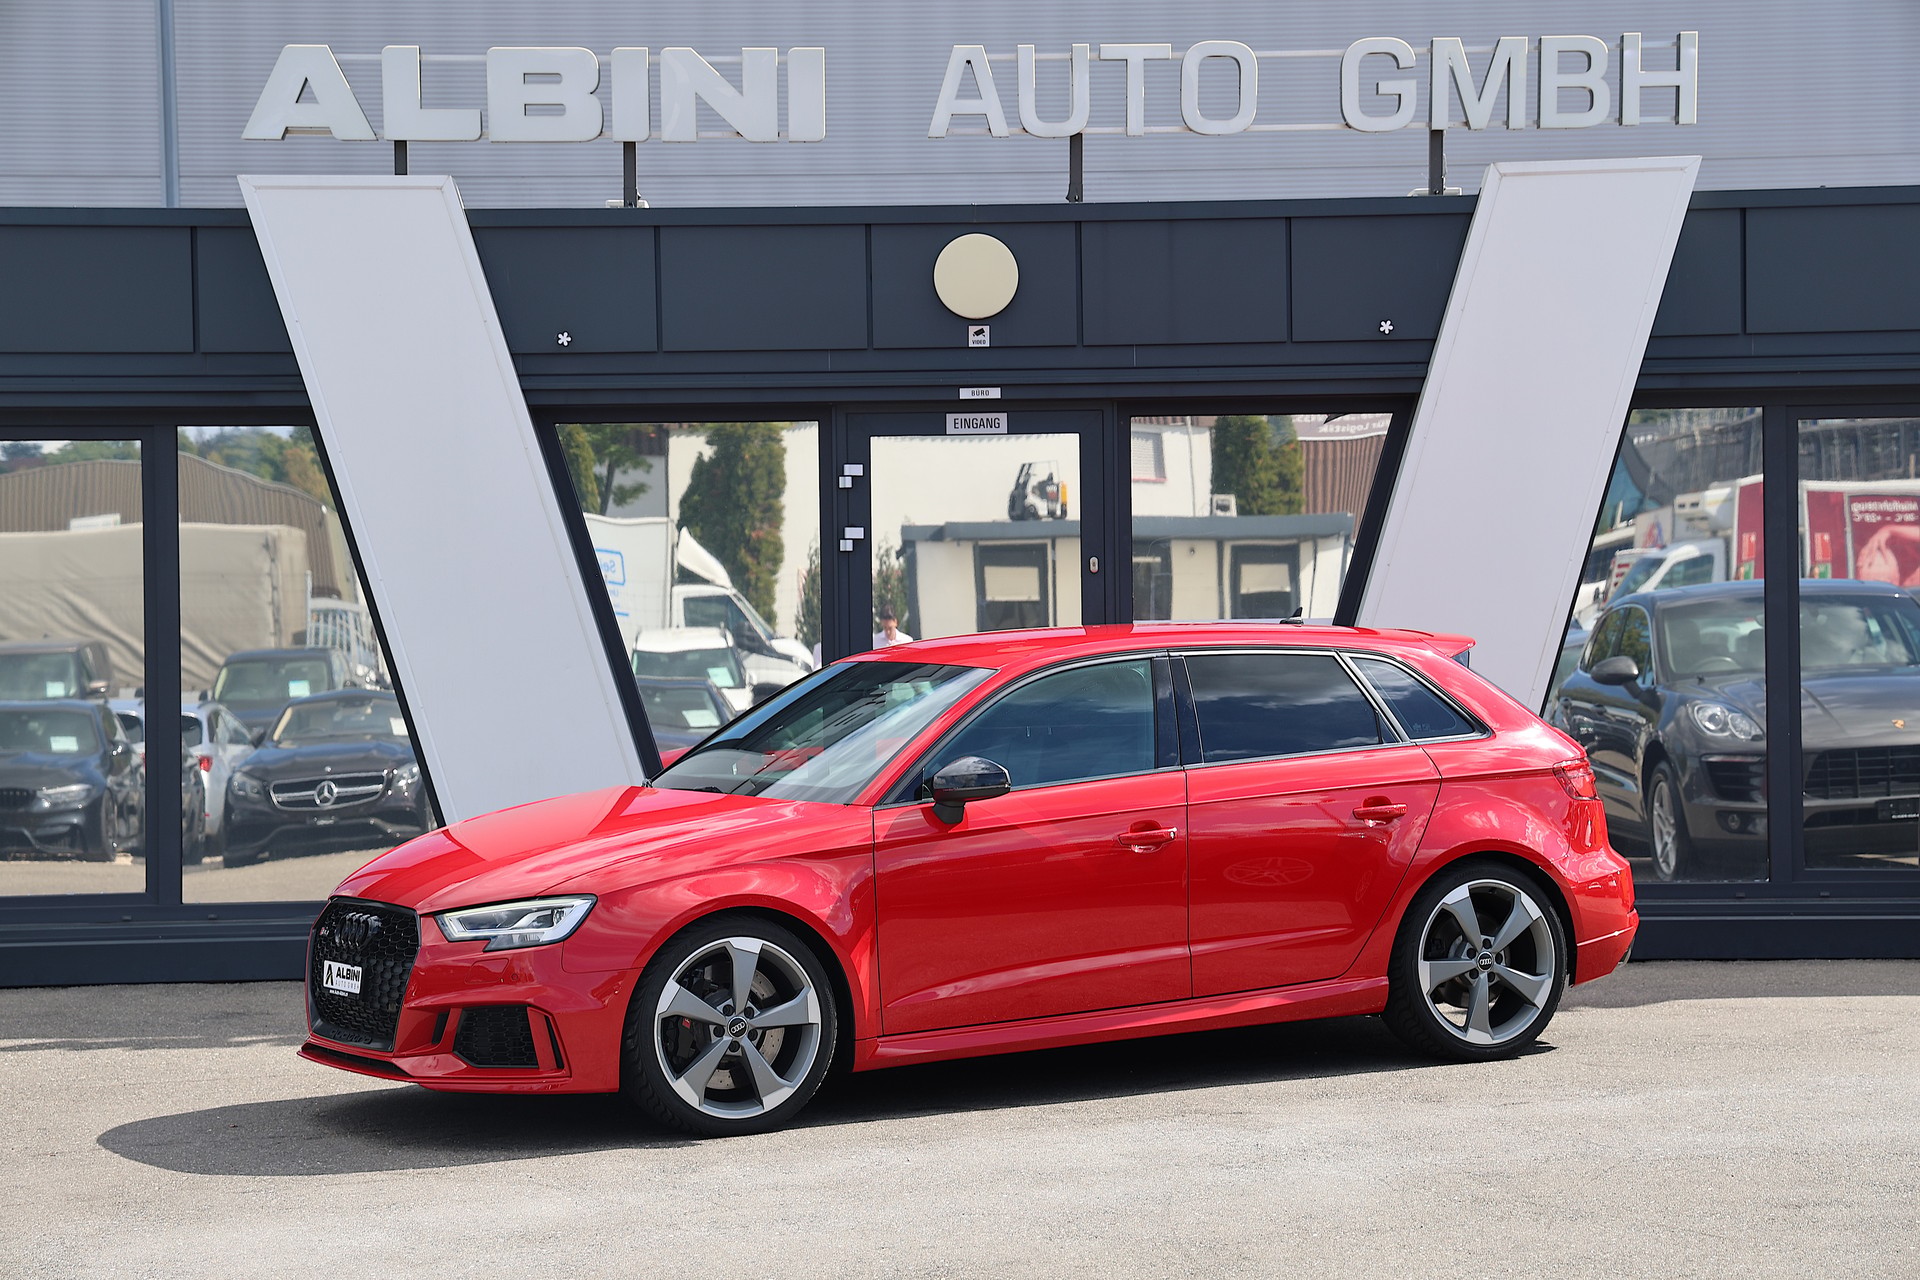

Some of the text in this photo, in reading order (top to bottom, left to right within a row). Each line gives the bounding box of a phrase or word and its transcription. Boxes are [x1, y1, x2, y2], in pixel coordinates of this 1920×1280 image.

[241, 30, 1699, 142] ALBINI AUTO GMBH
[971, 389, 990, 397] BÜRO
[953, 417, 1001, 429] EINGANG
[336, 966, 360, 982] ALBINI
